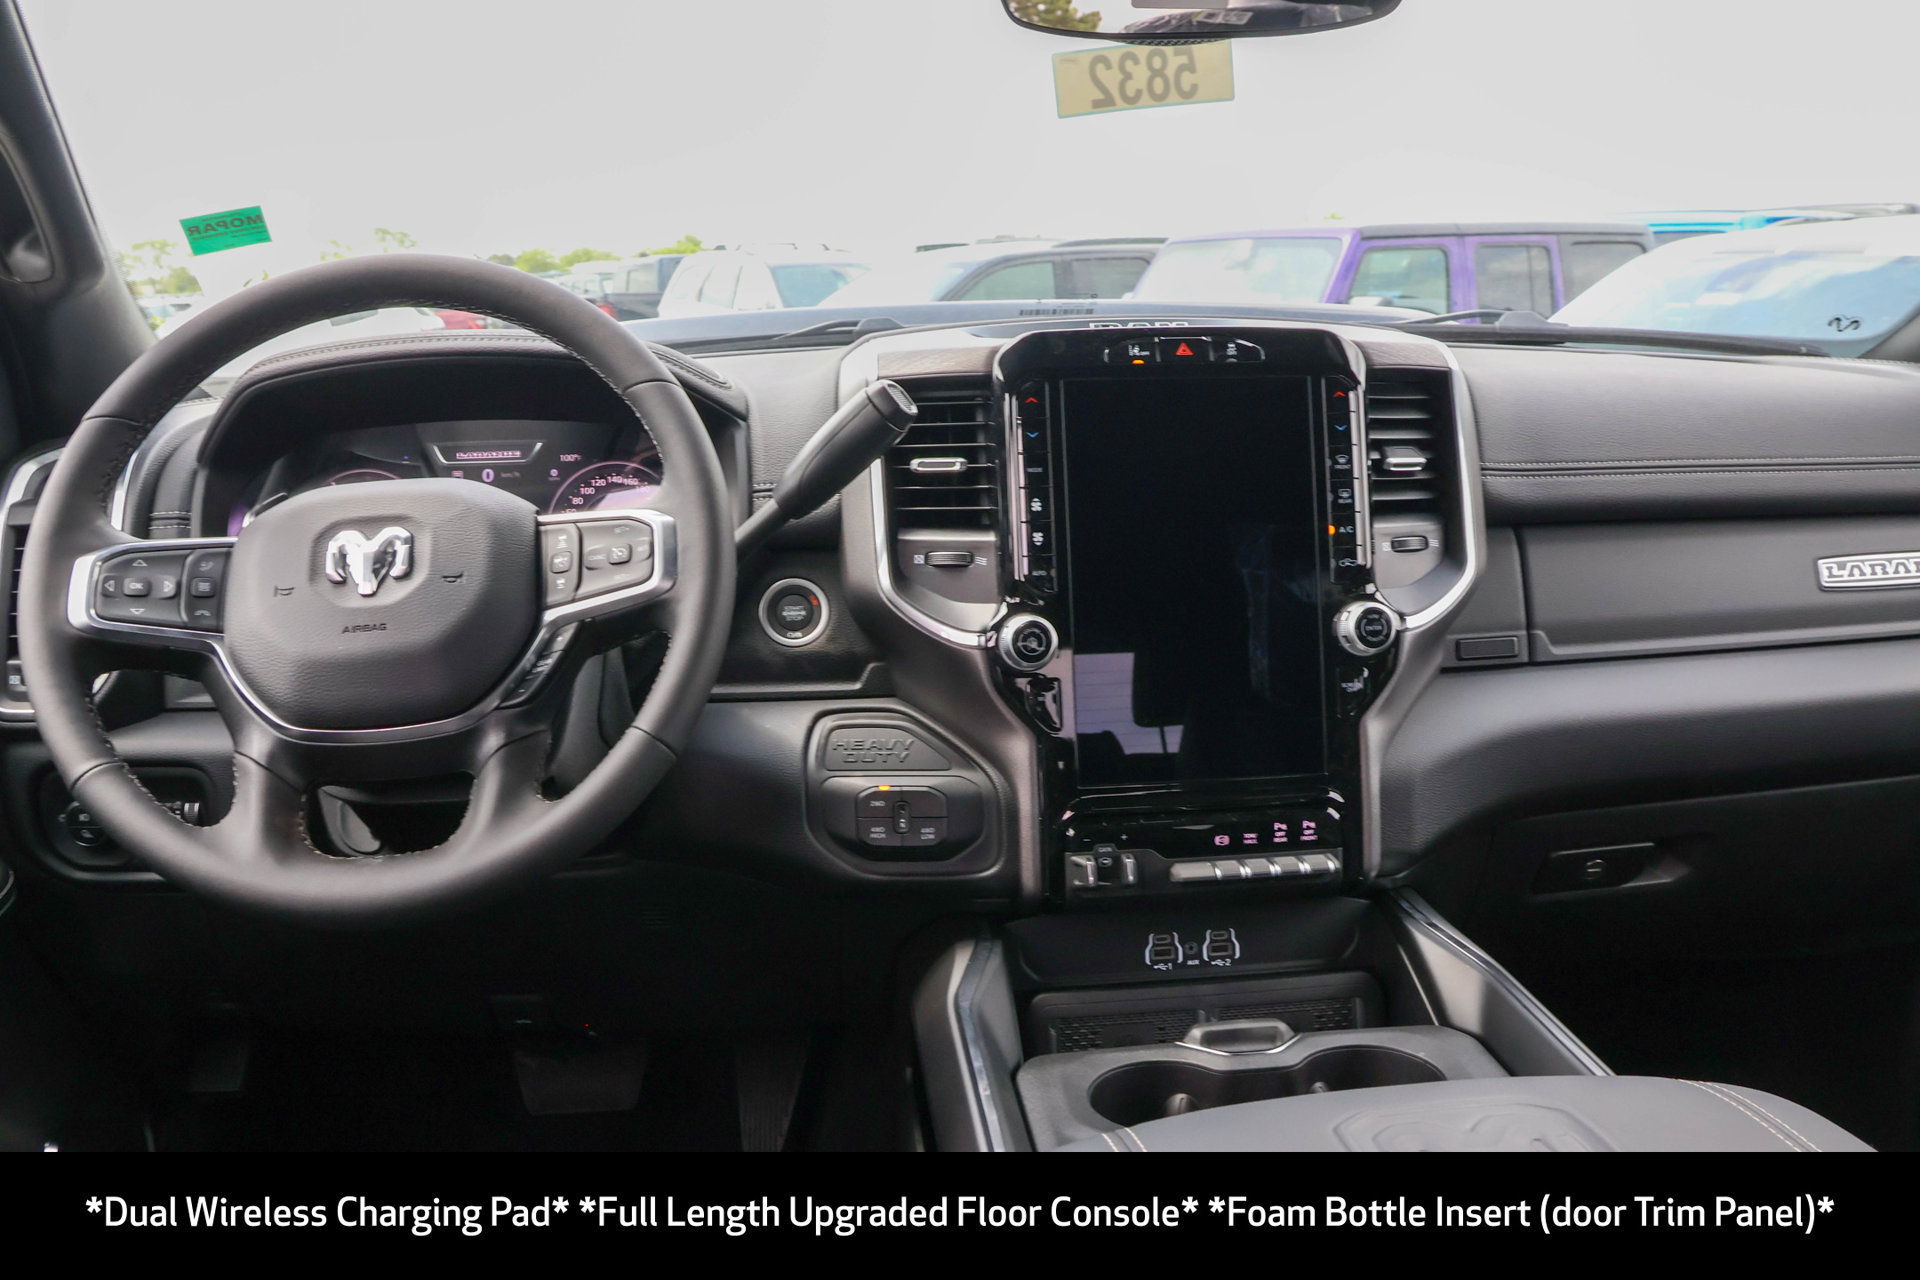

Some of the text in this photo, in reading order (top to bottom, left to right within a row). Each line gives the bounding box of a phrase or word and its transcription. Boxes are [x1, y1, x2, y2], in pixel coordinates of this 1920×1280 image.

[481, 468, 495, 483] 0
[607, 475, 623, 483] 140
[591, 479, 606, 487] 120
[624, 477, 639, 485] 160
[580, 487, 595, 495] 100
[571, 497, 584, 505] 80
[129, 582, 144, 590] OK
[341, 622, 388, 634] AIRBAG
[832, 739, 914, 751] HEAVY
[842, 751, 910, 763] DUTY
